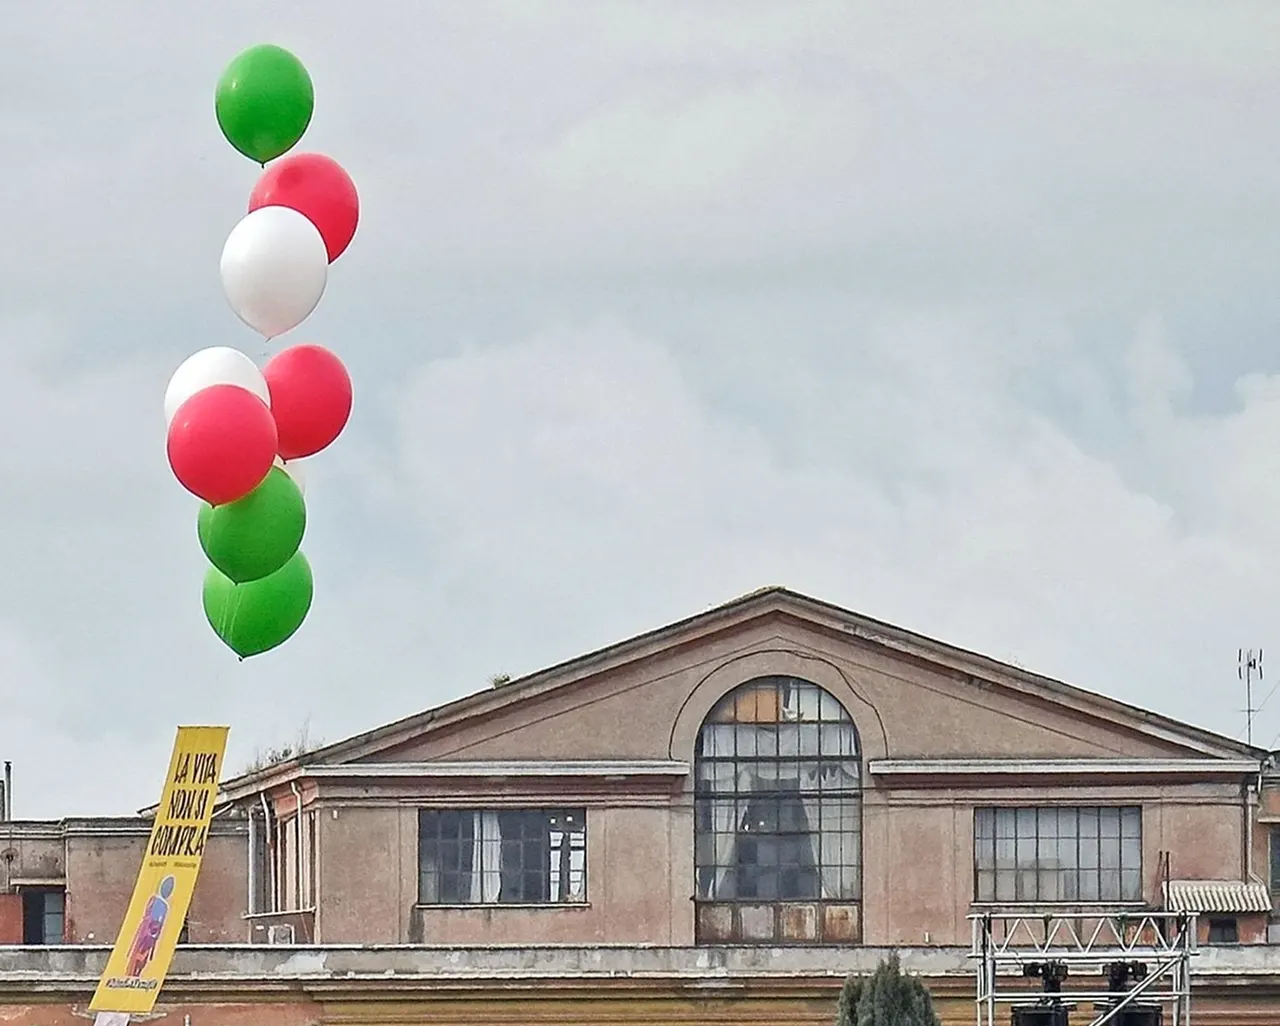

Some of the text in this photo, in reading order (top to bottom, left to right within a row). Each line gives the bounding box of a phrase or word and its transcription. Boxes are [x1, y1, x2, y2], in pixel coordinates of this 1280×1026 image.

[173, 751, 218, 784] LA VITA
[169, 788, 209, 821] NON SI
[150, 824, 205, 857] COMPRA
